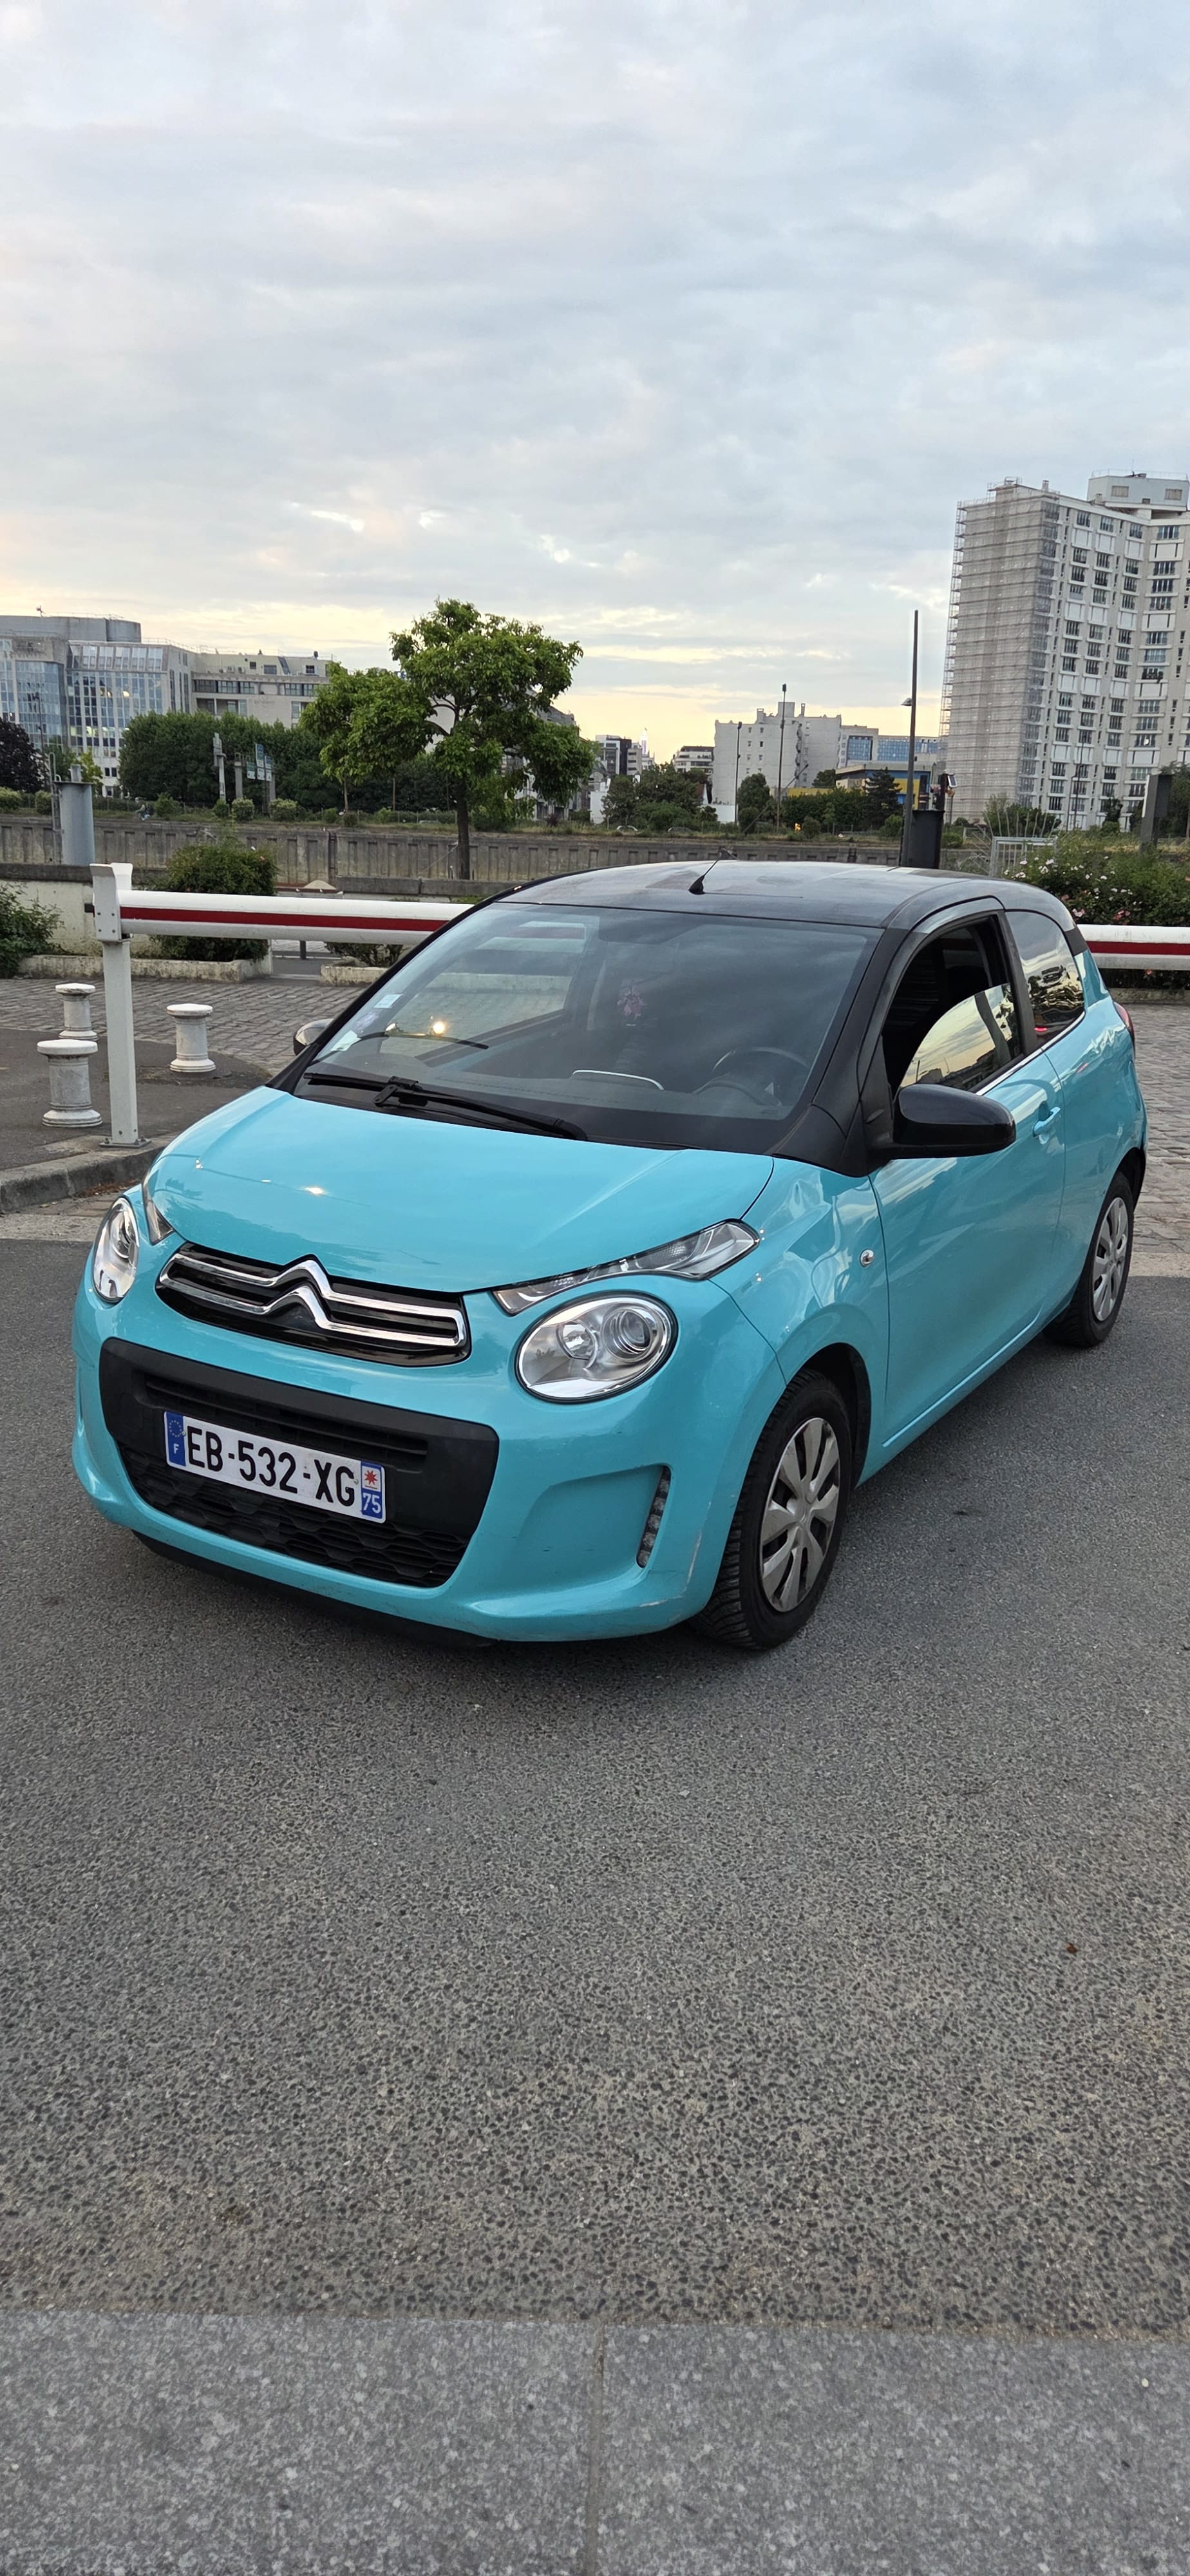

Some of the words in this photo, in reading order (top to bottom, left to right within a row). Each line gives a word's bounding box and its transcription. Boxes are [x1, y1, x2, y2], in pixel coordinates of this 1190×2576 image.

[173, 1443, 180, 1455] F
[187, 1425, 355, 1507] EB-532-XG
[363, 1492, 382, 1514] 75
